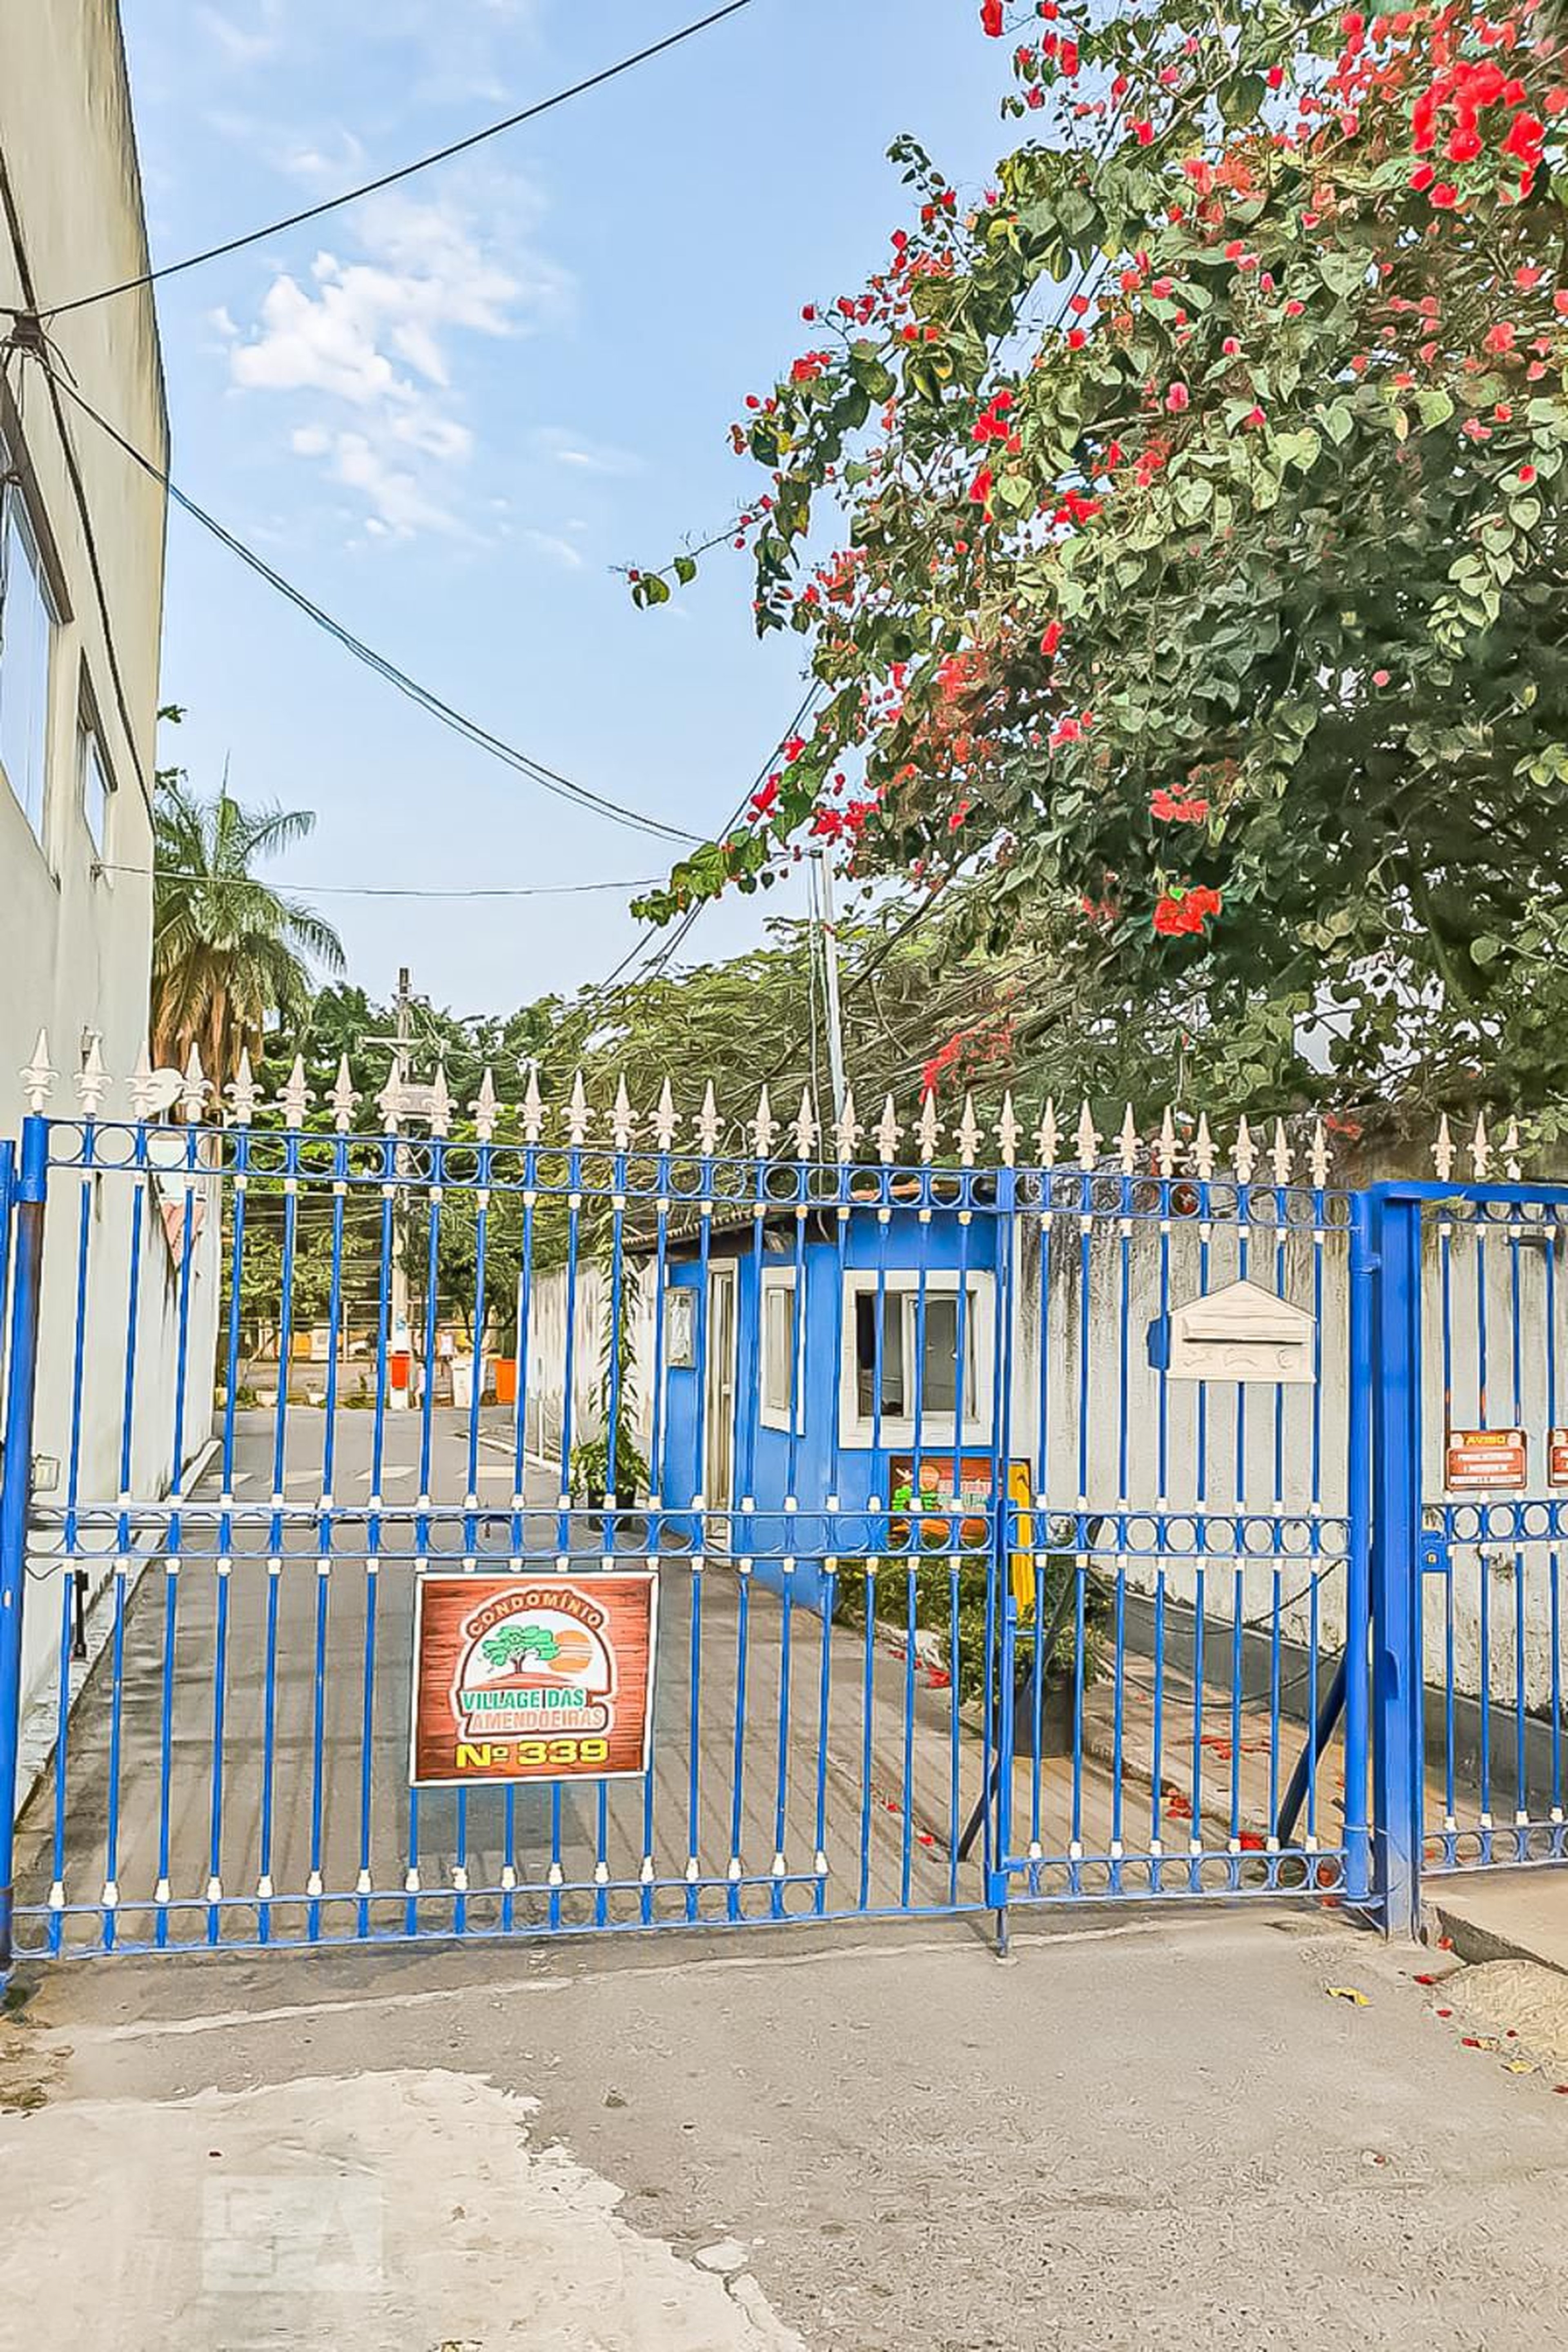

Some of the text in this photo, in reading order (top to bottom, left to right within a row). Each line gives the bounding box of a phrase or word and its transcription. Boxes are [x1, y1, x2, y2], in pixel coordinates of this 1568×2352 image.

[469, 1592, 601, 1635] CONDOMÍNIO
[463, 1689, 584, 1710] VILLAGE DAS
[472, 1708, 603, 1730] AMENDOEIRAS
[517, 1738, 609, 1765] 339
